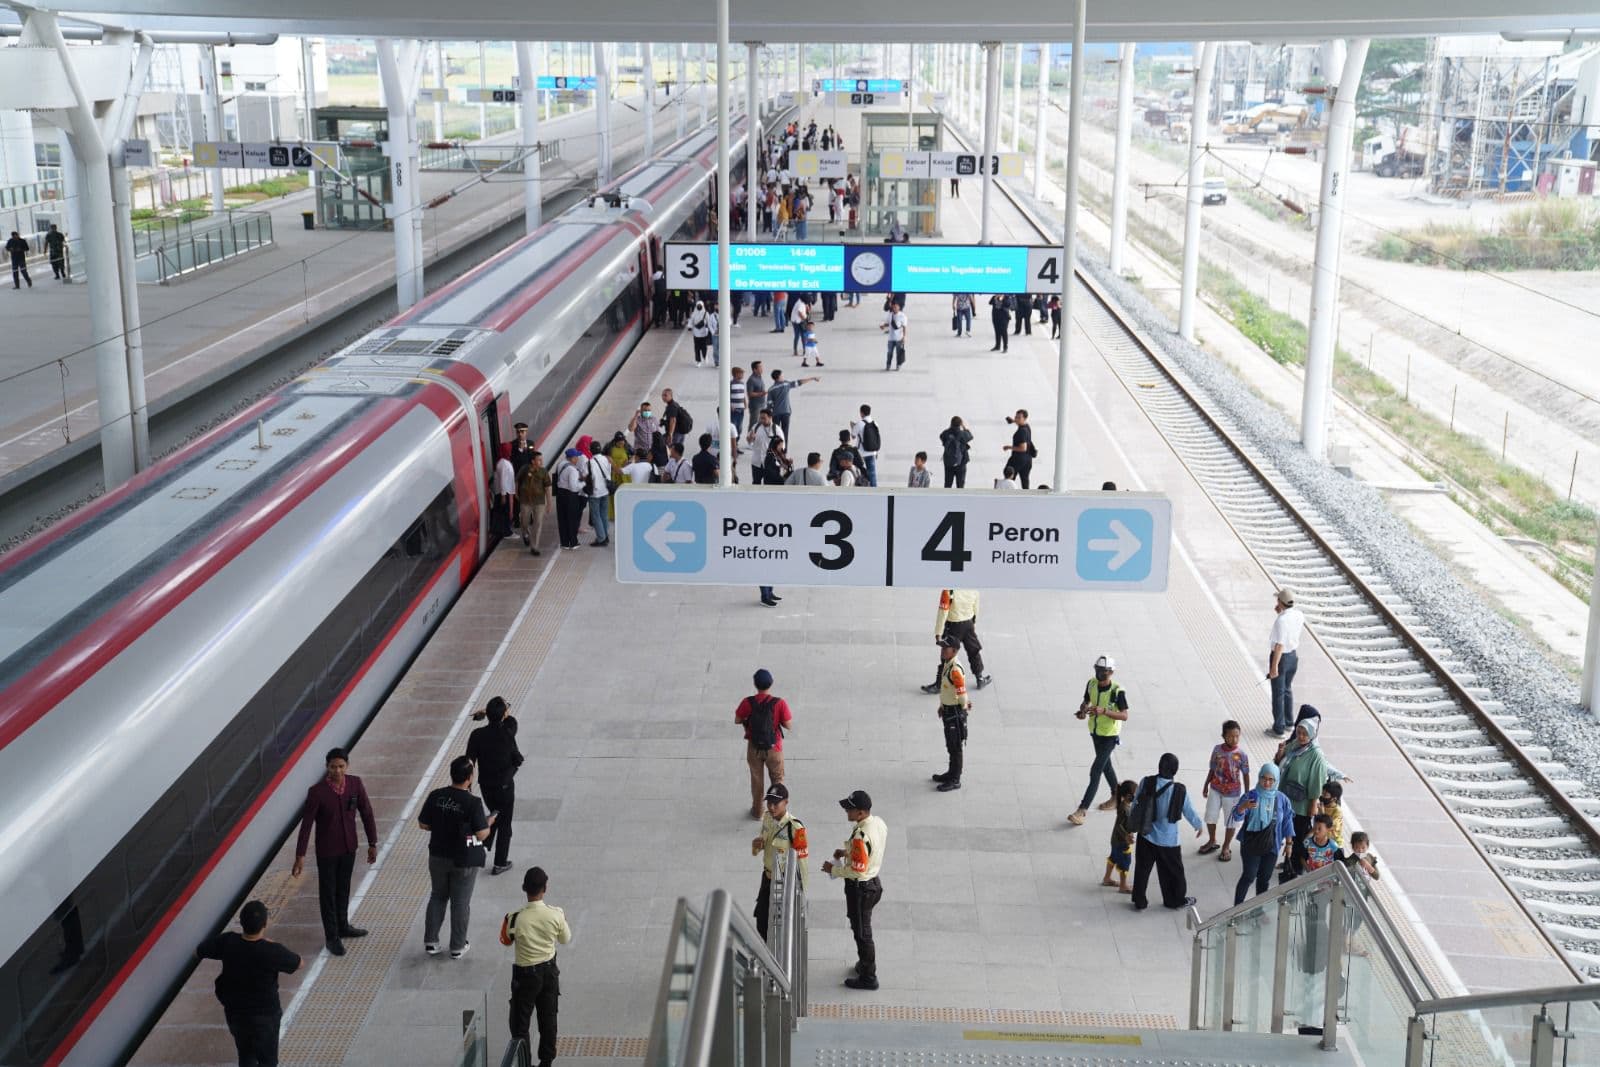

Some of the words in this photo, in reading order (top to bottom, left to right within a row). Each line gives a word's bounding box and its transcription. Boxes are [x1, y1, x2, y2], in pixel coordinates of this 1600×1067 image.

[679, 252, 700, 279] 3
[1037, 257, 1060, 284] 4
[735, 279, 747, 288] Go
[749, 279, 786, 288] Forward
[787, 279, 801, 288] for
[802, 279, 820, 288] Exit
[722, 517, 793, 538] Peron
[988, 522, 1060, 543] Peron
[808, 509, 855, 571] 3
[920, 511, 973, 572] 4
[722, 544, 789, 561] Platform
[991, 549, 1059, 566] Platform
